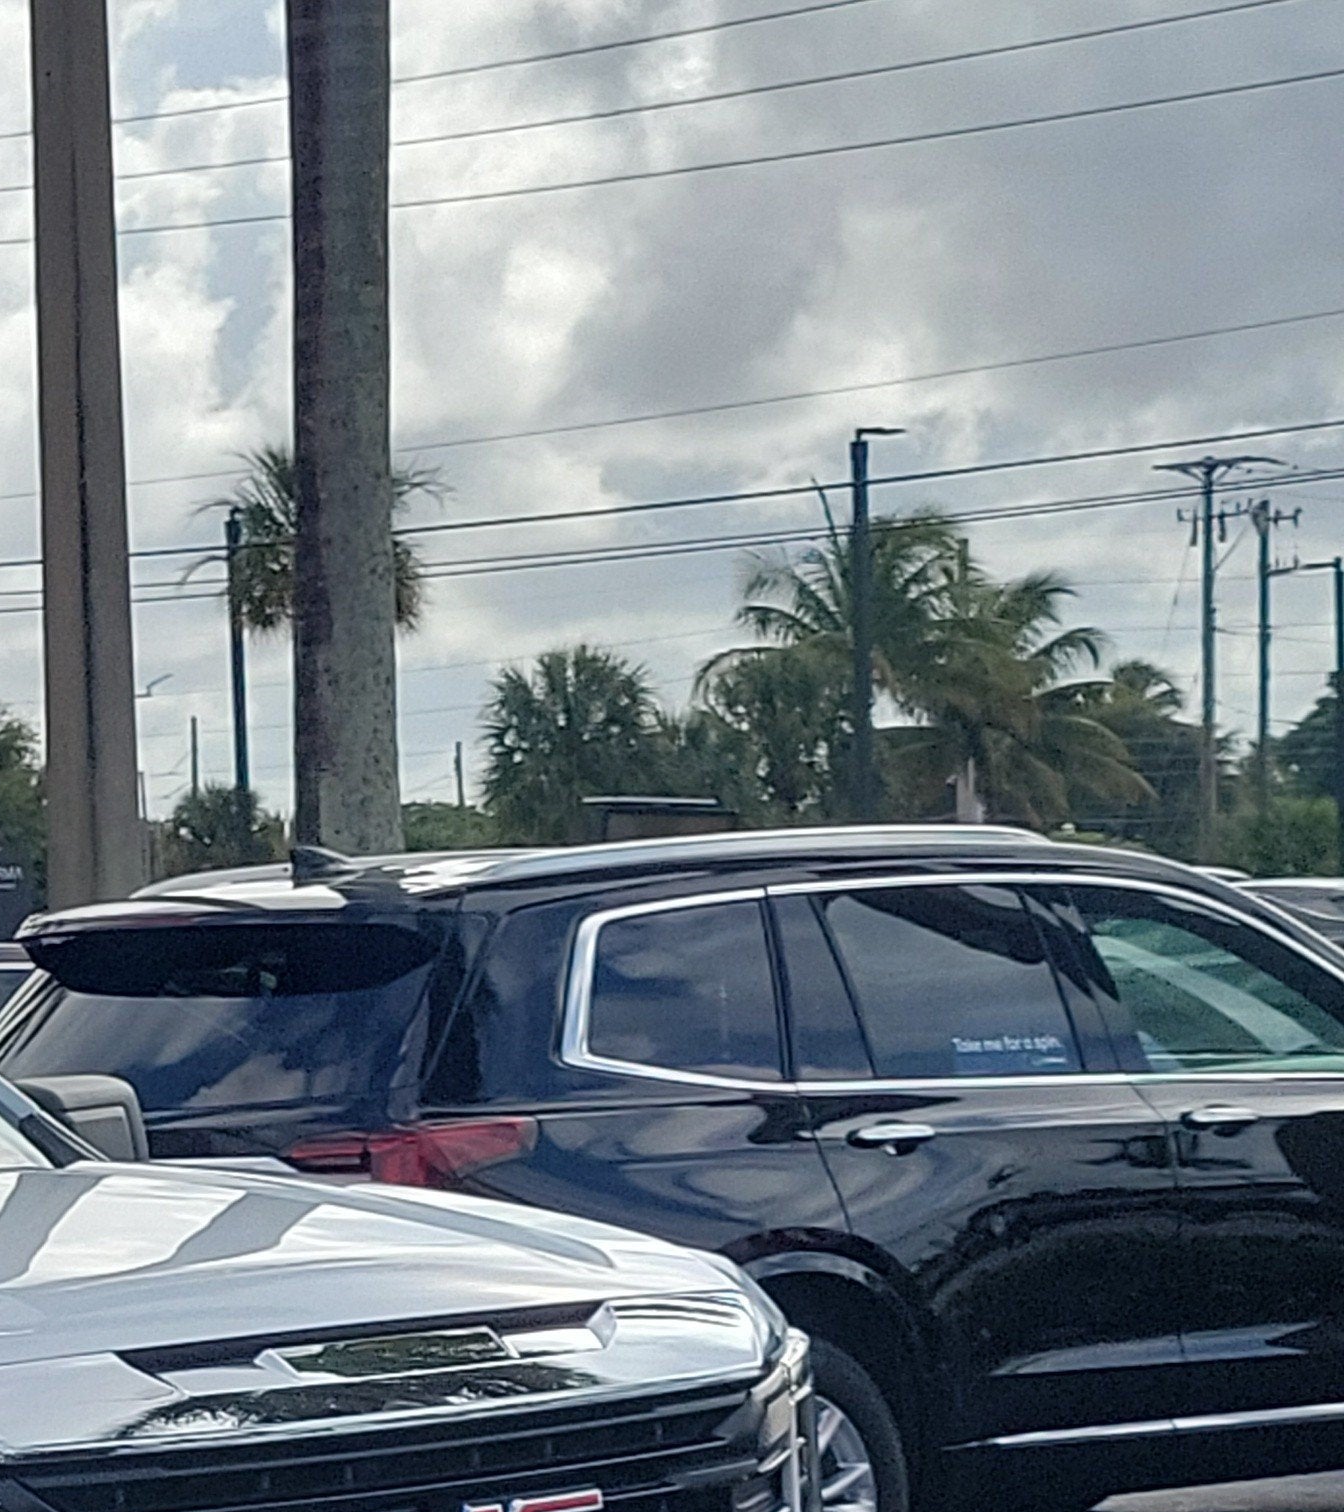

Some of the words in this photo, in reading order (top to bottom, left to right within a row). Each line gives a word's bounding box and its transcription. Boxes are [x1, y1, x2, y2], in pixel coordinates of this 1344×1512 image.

[952, 1038, 982, 1053] Take
[983, 1040, 1003, 1052] me
[1003, 1036, 1021, 1051] for
[1023, 1039, 1033, 1050] a
